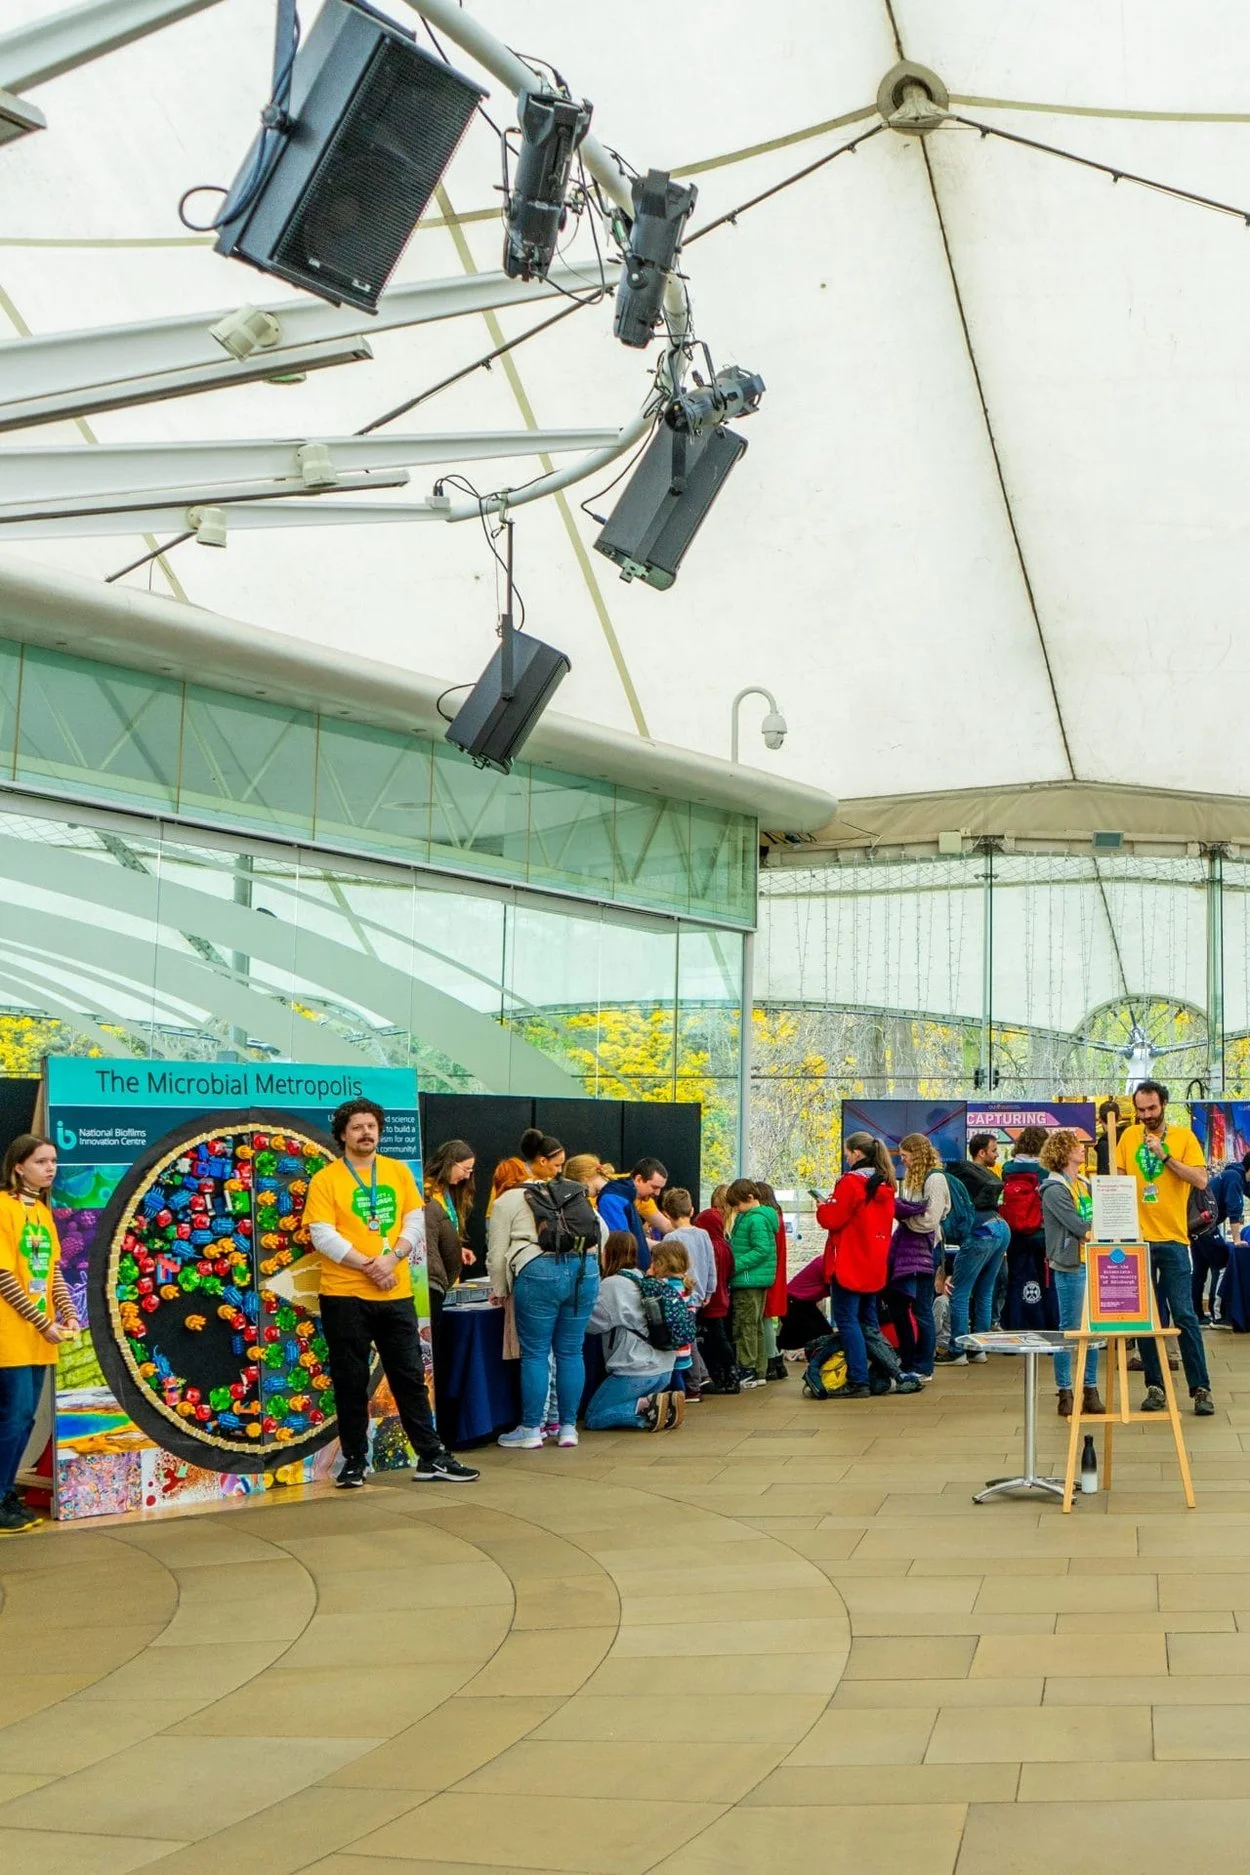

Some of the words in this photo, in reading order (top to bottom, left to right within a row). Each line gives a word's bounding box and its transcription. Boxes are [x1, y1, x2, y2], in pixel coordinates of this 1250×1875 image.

[96, 1069, 140, 1093] The
[147, 1071, 248, 1096] Microbial
[255, 1073, 363, 1101] Metropolis
[391, 1115, 415, 1123] science
[966, 1112, 1047, 1125] CAPTURING
[78, 1128, 114, 1138] National
[115, 1128, 147, 1137] Biofilms
[393, 1125, 410, 1133] build
[78, 1137, 120, 1146] Innovation
[120, 1137, 147, 1146] Centre
[394, 1135, 403, 1143] for
[380, 1146, 417, 1155] community!
